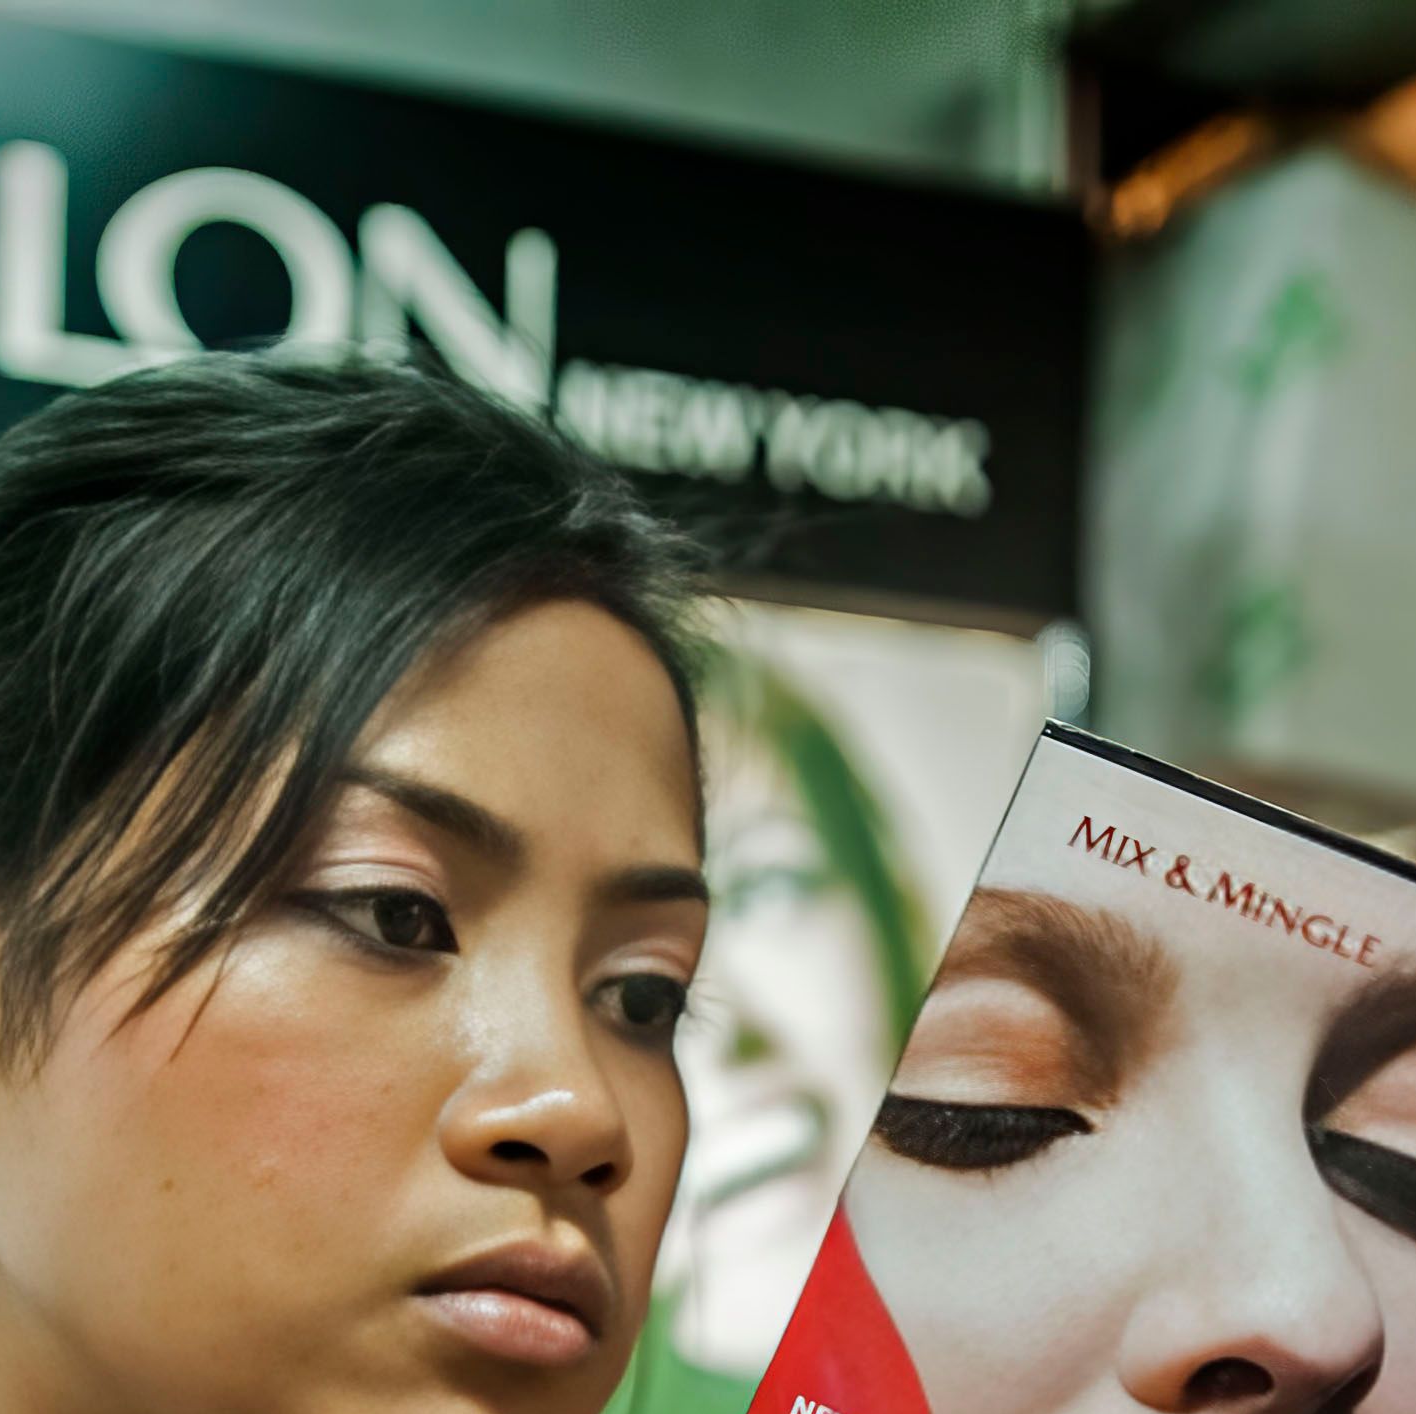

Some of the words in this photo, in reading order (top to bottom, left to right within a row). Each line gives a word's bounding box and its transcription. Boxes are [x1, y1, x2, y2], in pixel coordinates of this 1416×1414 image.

[761, 388, 993, 518] YORK
[1067, 816, 1157, 878] MIX
[1164, 853, 1198, 897] &
[1206, 871, 1382, 969] MINGLE
